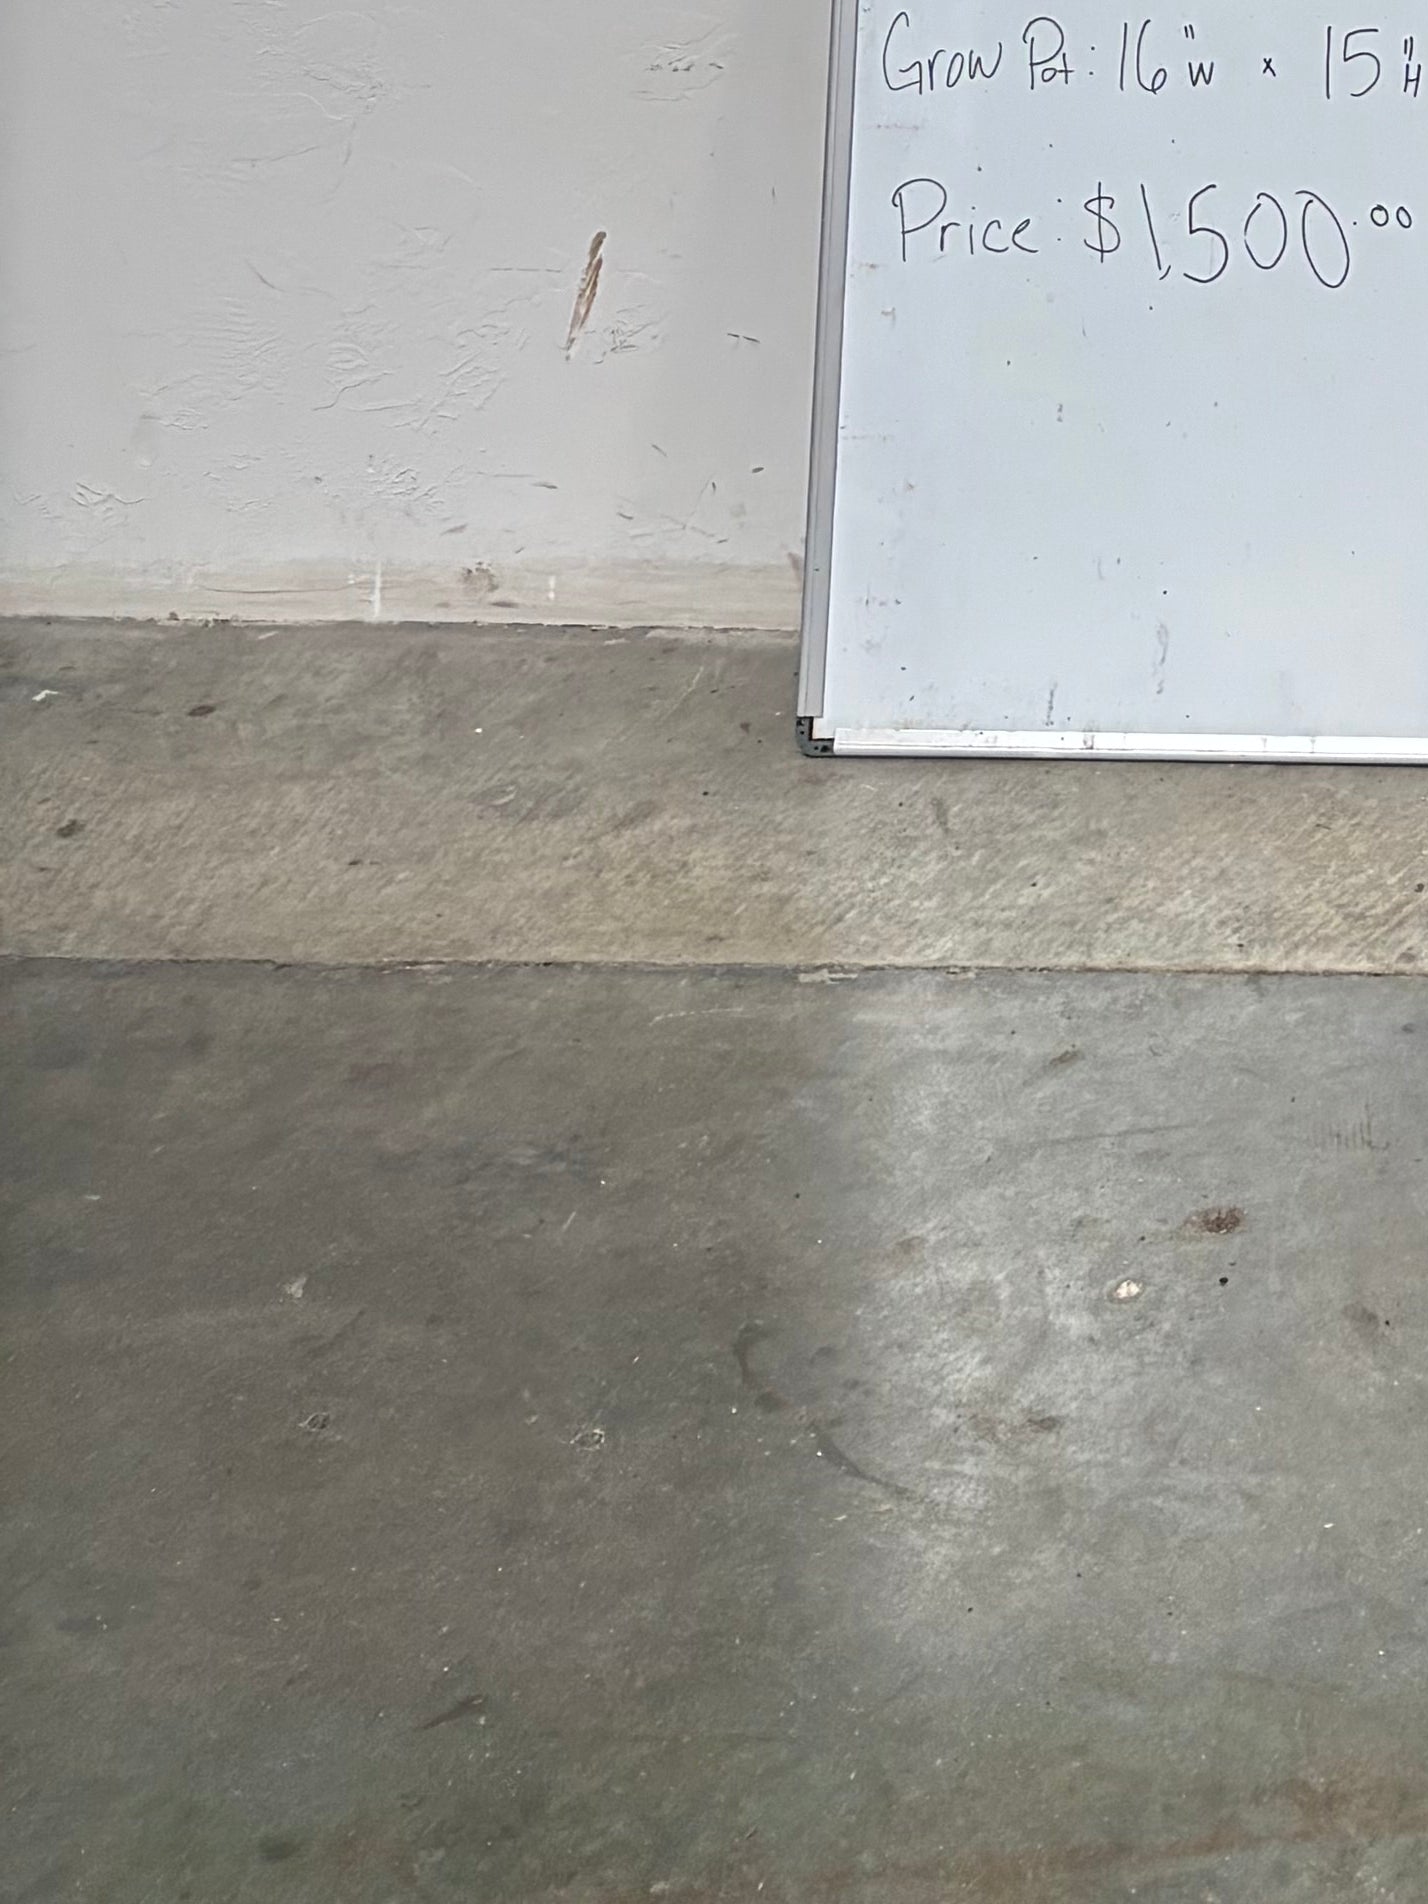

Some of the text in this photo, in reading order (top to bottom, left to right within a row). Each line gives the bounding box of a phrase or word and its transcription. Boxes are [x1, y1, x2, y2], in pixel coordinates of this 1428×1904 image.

[882, 11, 1003, 96] Grow
[1021, 16, 1096, 91] Pot:
[891, 177, 1063, 263] Price:
